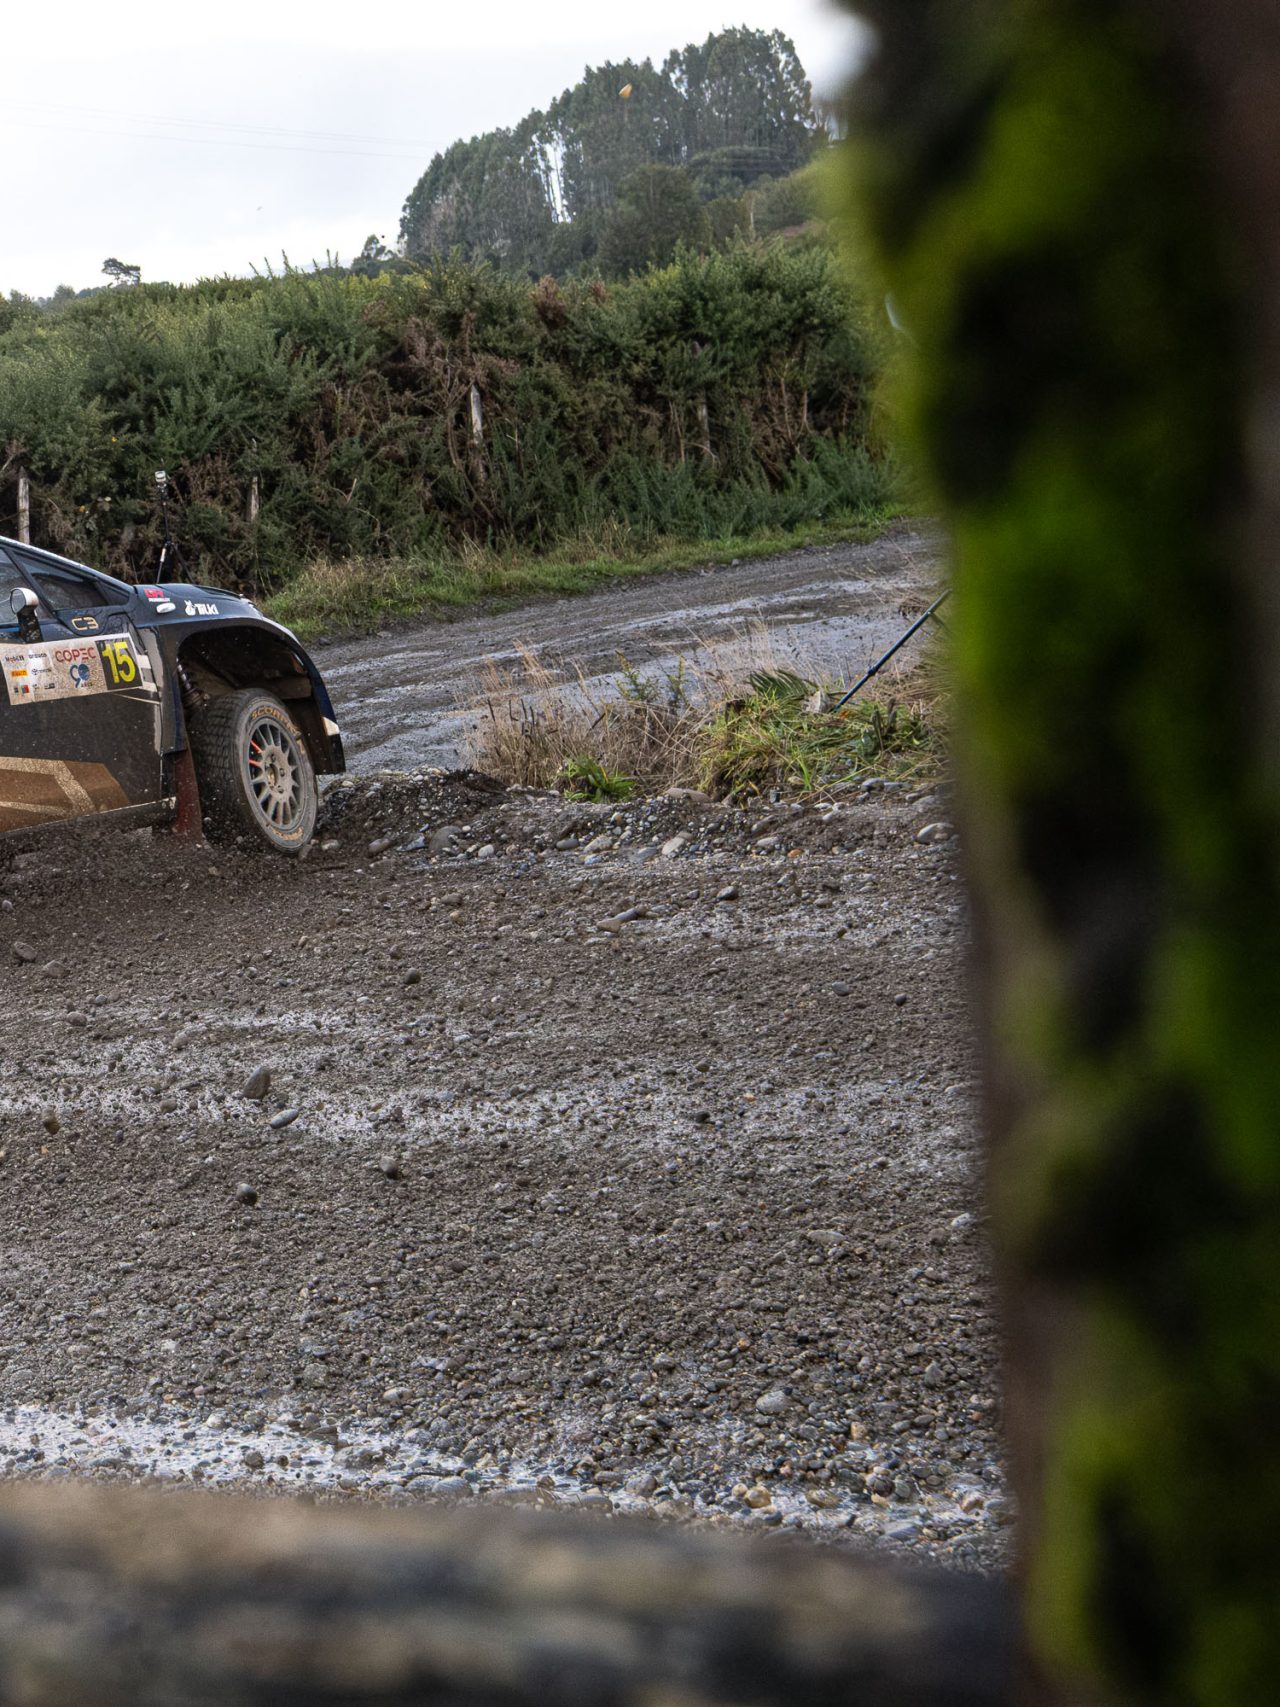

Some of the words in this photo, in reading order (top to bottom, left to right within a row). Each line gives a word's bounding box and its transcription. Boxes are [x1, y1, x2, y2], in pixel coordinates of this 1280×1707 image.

[72, 616, 99, 631] C3
[55, 647, 96, 662] COPEC
[102, 642, 136, 683] 15
